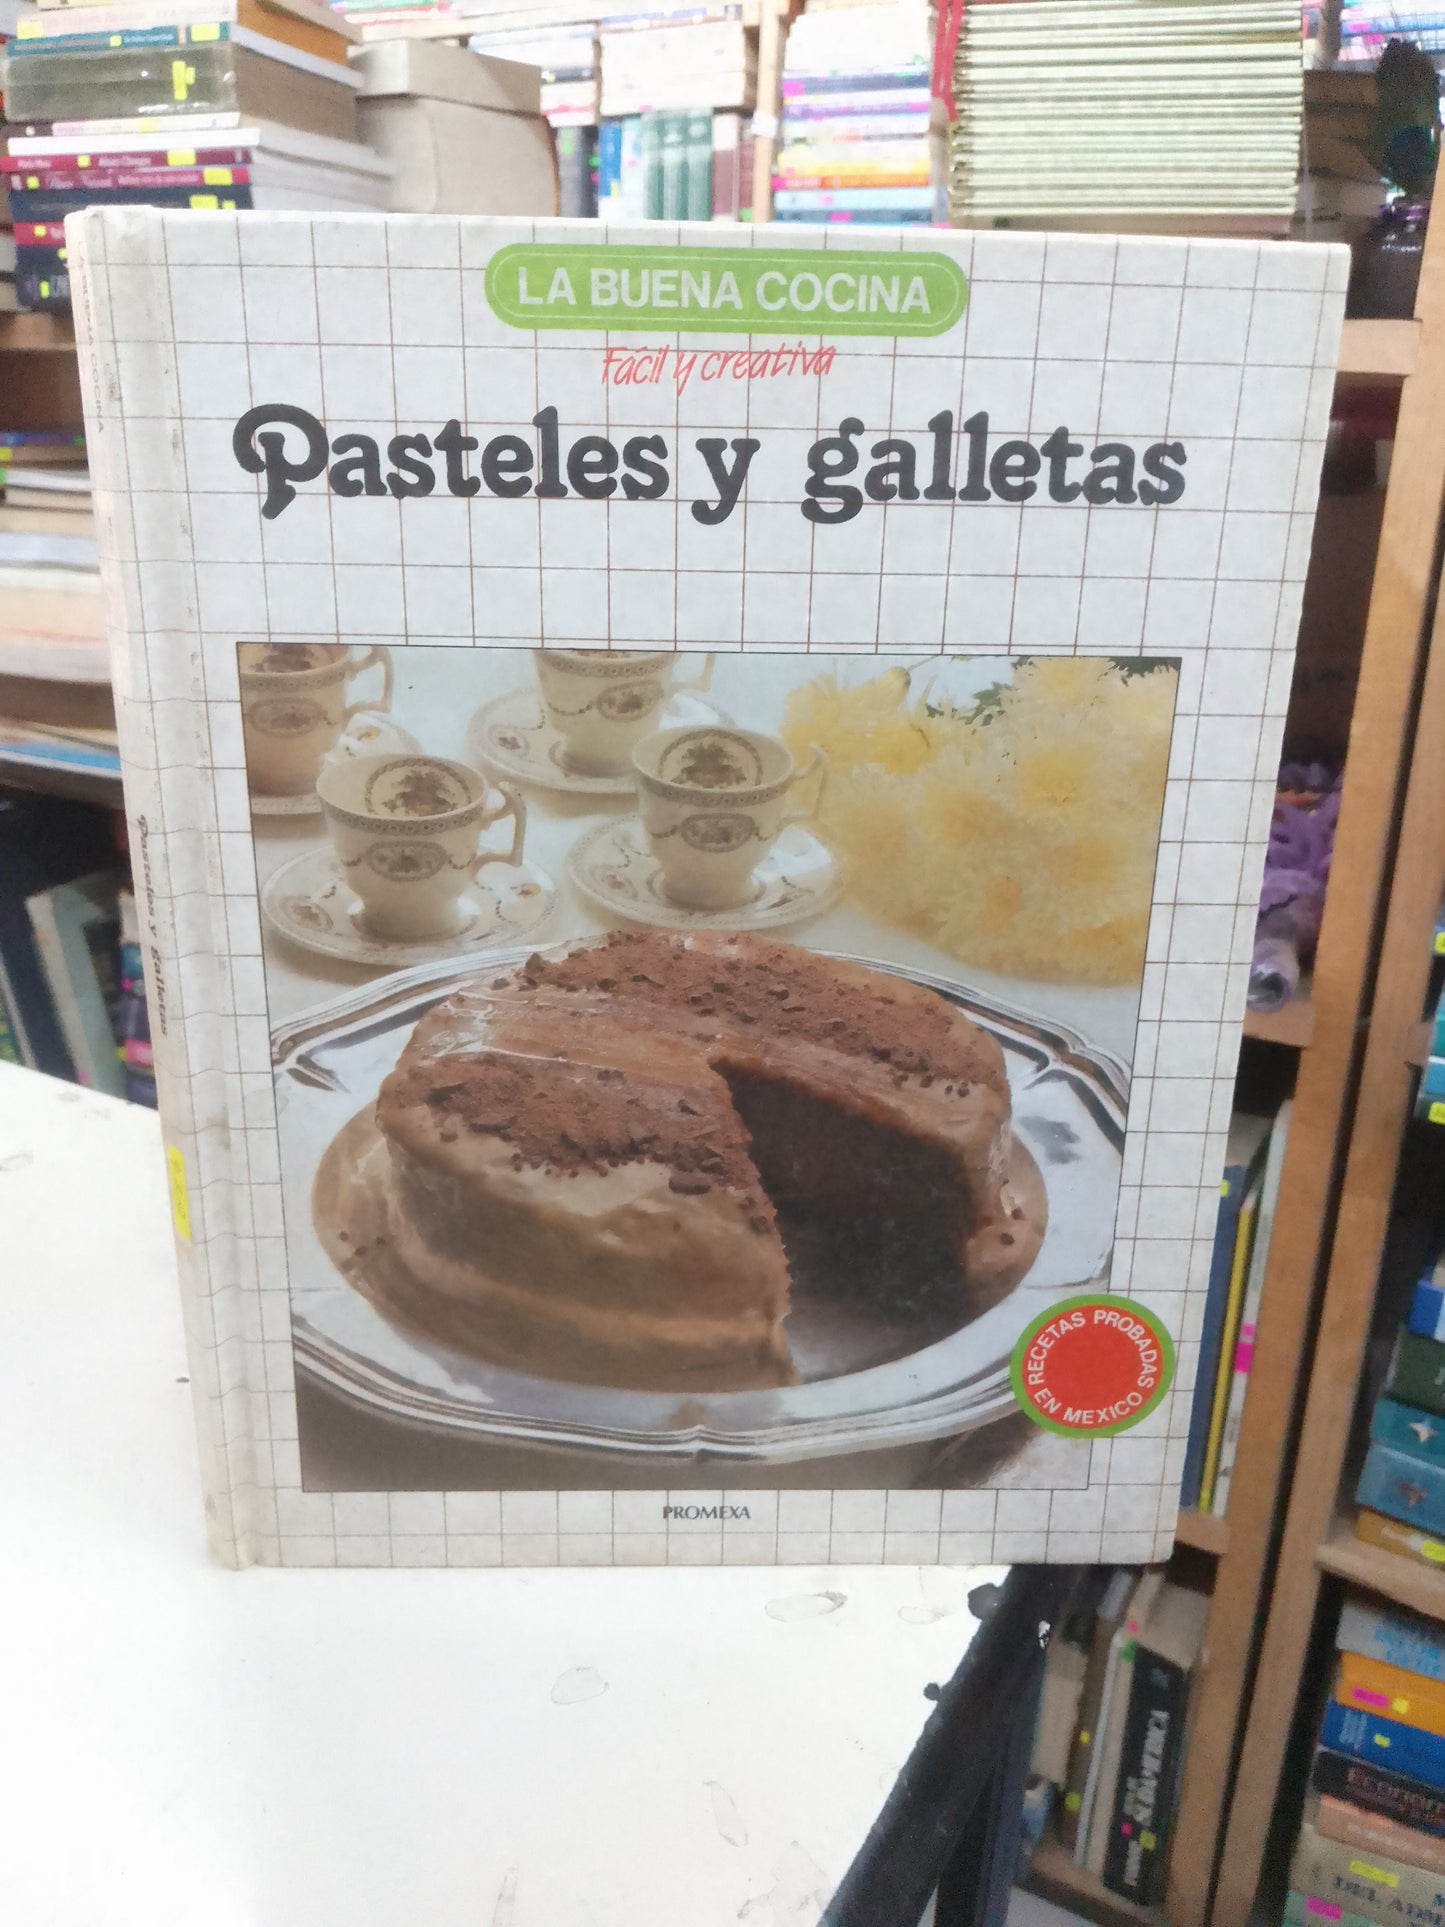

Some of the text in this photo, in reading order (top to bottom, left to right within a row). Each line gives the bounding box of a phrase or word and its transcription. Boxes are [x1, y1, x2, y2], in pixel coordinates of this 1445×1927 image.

[517, 266, 931, 314] LA BUENA COCINA
[90, 353, 105, 433] COCINA
[601, 340, 837, 397] Fácil y creativa
[233, 403, 1187, 525] Pasteles y galletas
[137, 815, 155, 916] Pasteles
[151, 946, 167, 1037] galletas
[1028, 1309, 1157, 1388] RECETAS PROBADAS
[1034, 1388, 1142, 1424] EN MEXICO
[663, 1505, 751, 1520] PROMEXA
